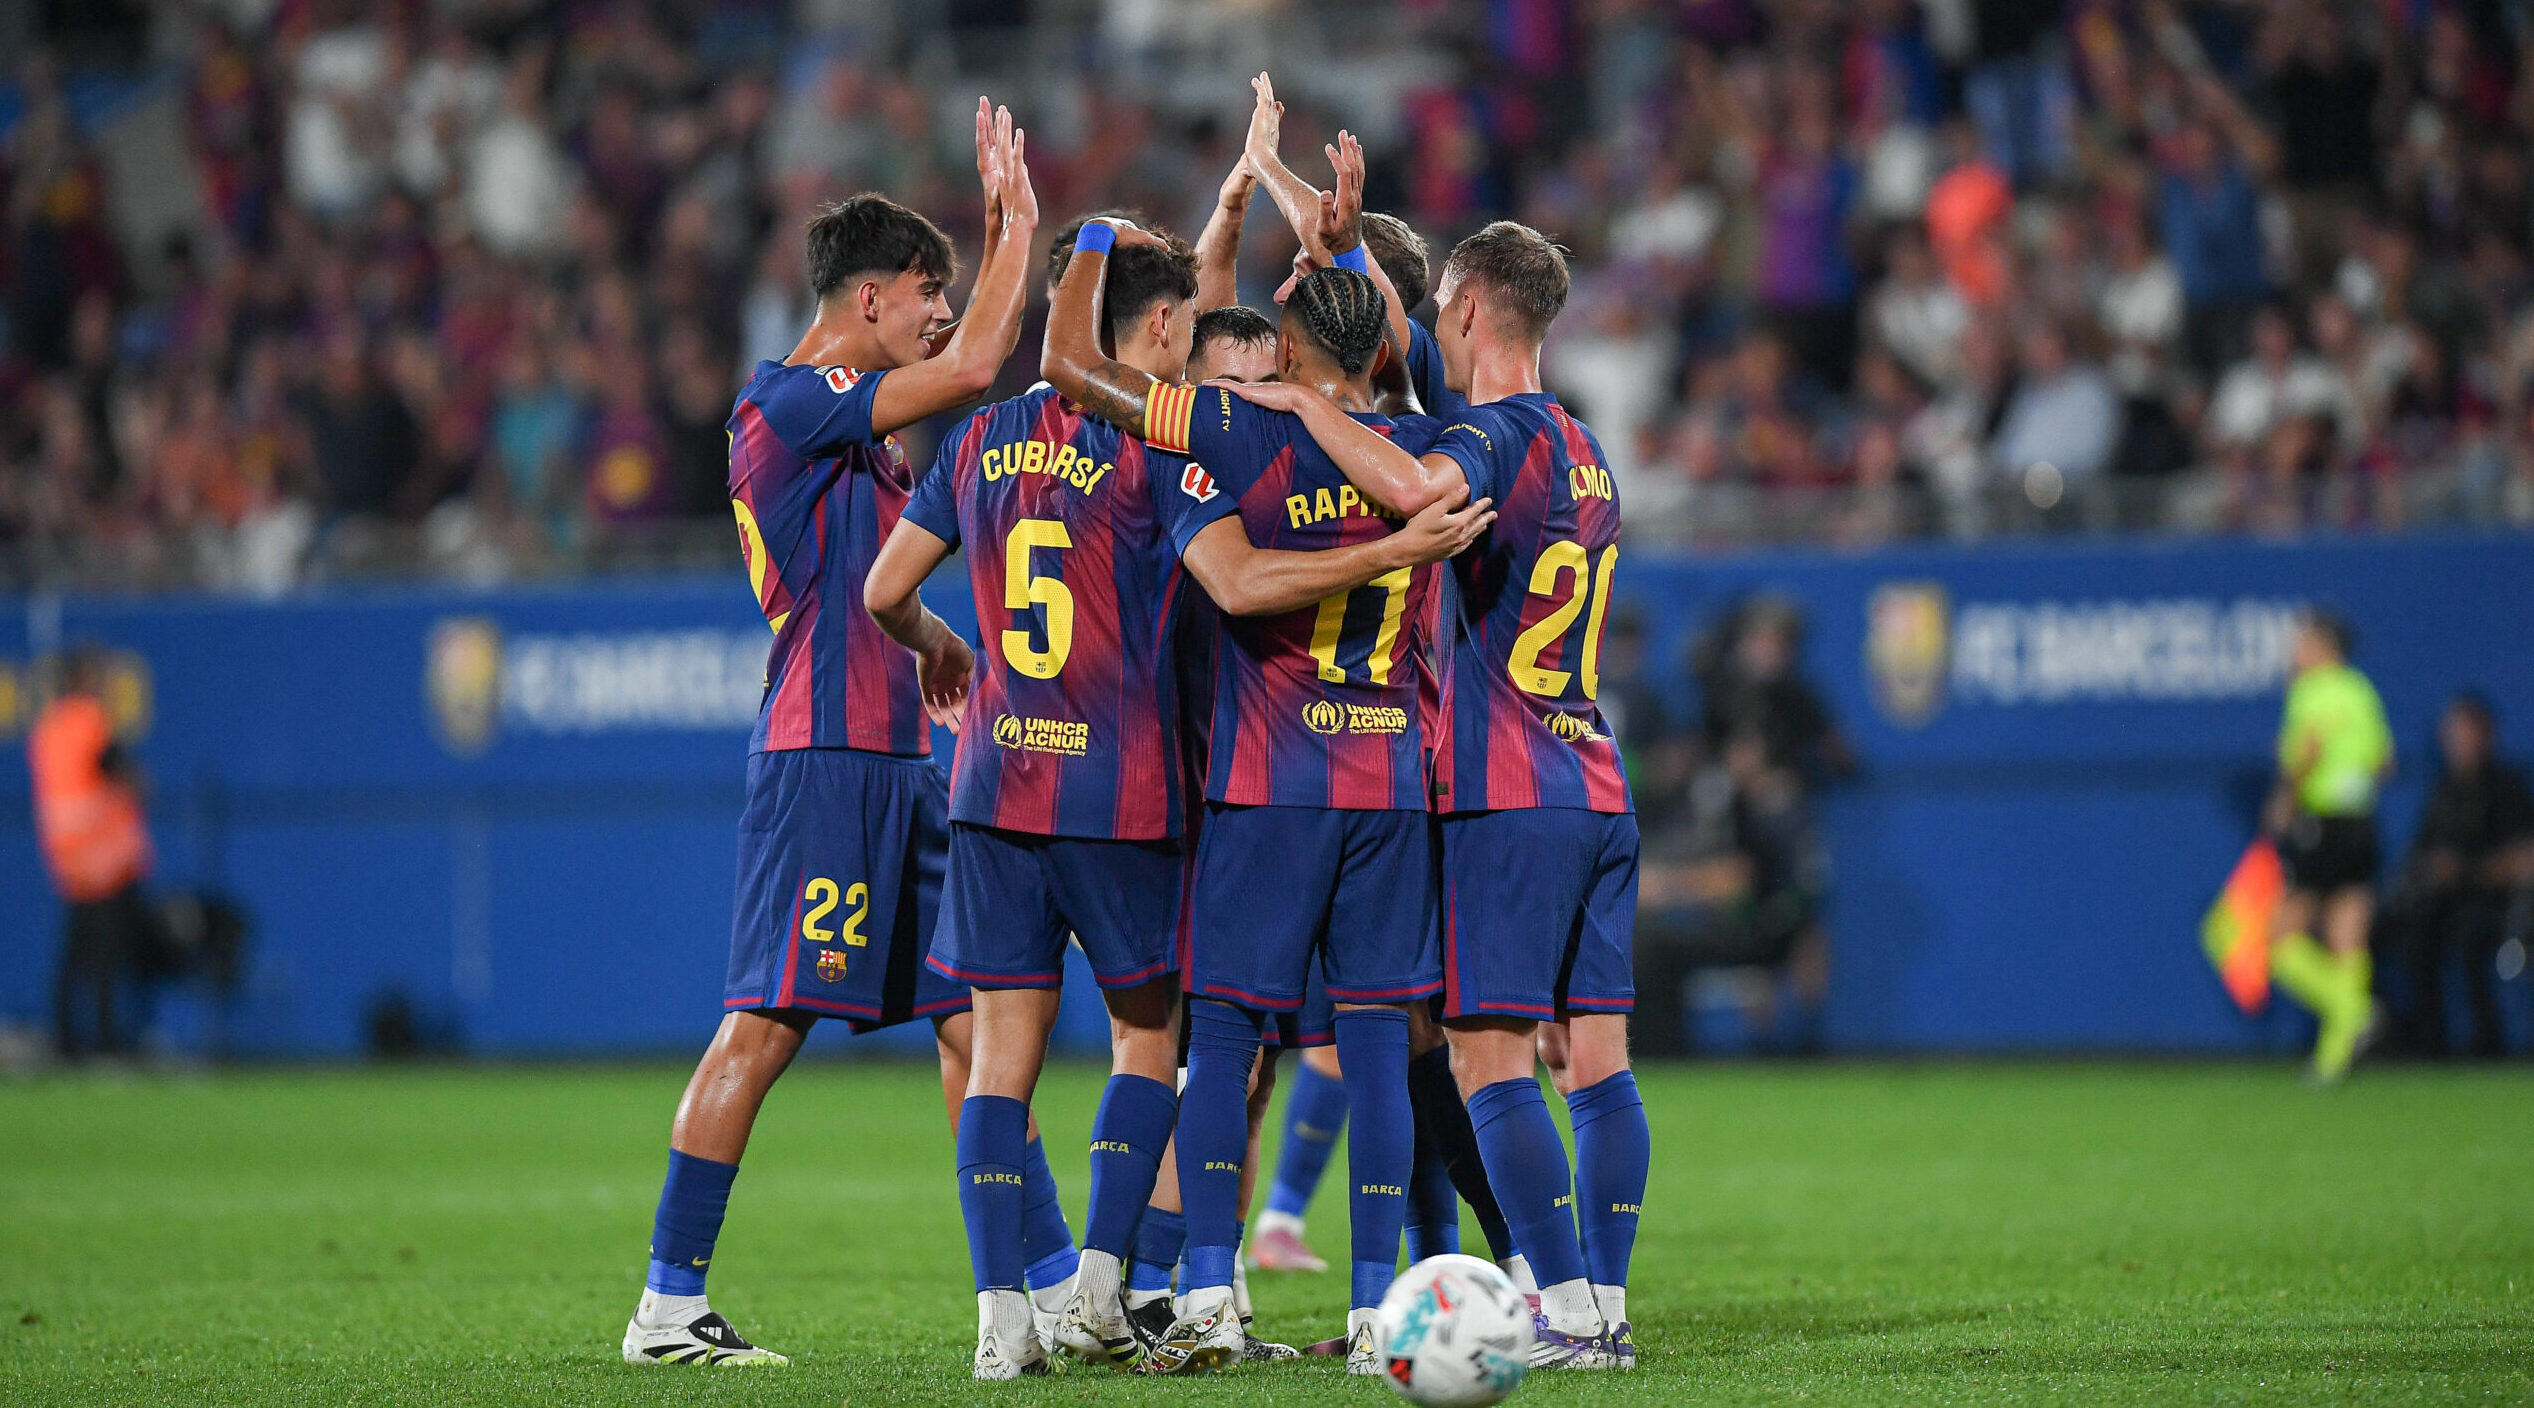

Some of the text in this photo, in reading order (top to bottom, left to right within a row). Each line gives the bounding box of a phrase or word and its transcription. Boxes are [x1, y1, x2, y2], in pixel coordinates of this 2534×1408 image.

[1220, 388, 1231, 417] LIGHT
[982, 440, 1114, 496] CUBARSÍ
[1001, 518, 1074, 680] 5
[1346, 703, 1407, 717] UNHCR
[1025, 717, 1089, 737] UNHCR
[1348, 715, 1408, 729] ACNUR
[1023, 731, 1087, 750] ACNUR
[1043, 746, 1065, 755] Refugee
[1065, 748, 1086, 757] Agency
[802, 877, 869, 948] 22
[973, 1173, 1022, 1186] BARÇA
[1361, 1184, 1402, 1196] BARÇA
